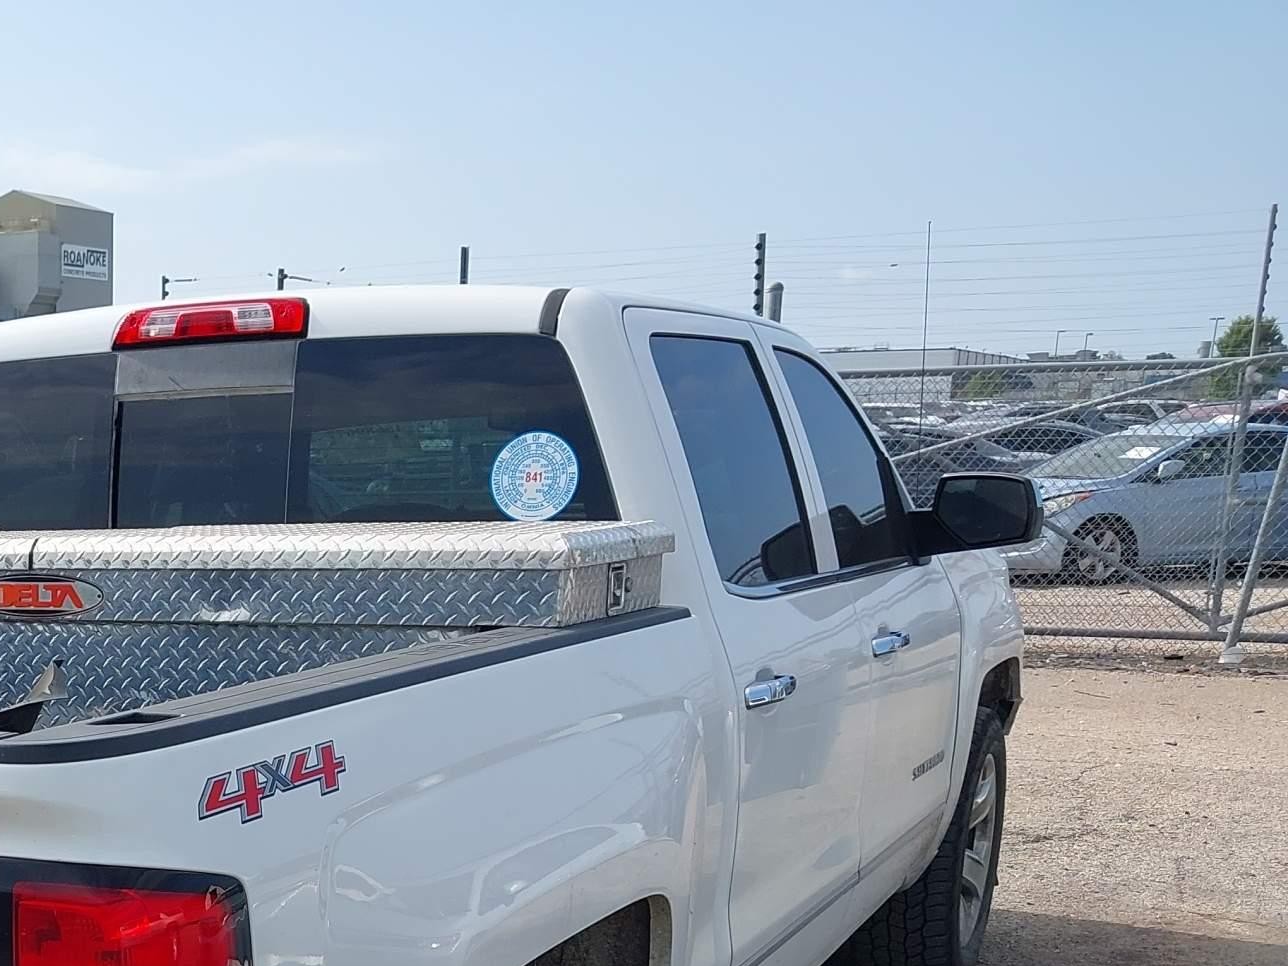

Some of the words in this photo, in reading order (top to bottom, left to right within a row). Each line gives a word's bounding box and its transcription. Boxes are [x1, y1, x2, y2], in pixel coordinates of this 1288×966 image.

[63, 249, 106, 268] ROANOKE
[506, 436, 528, 454] UNION
[532, 434, 542, 442] OF
[525, 471, 543, 483] 841
